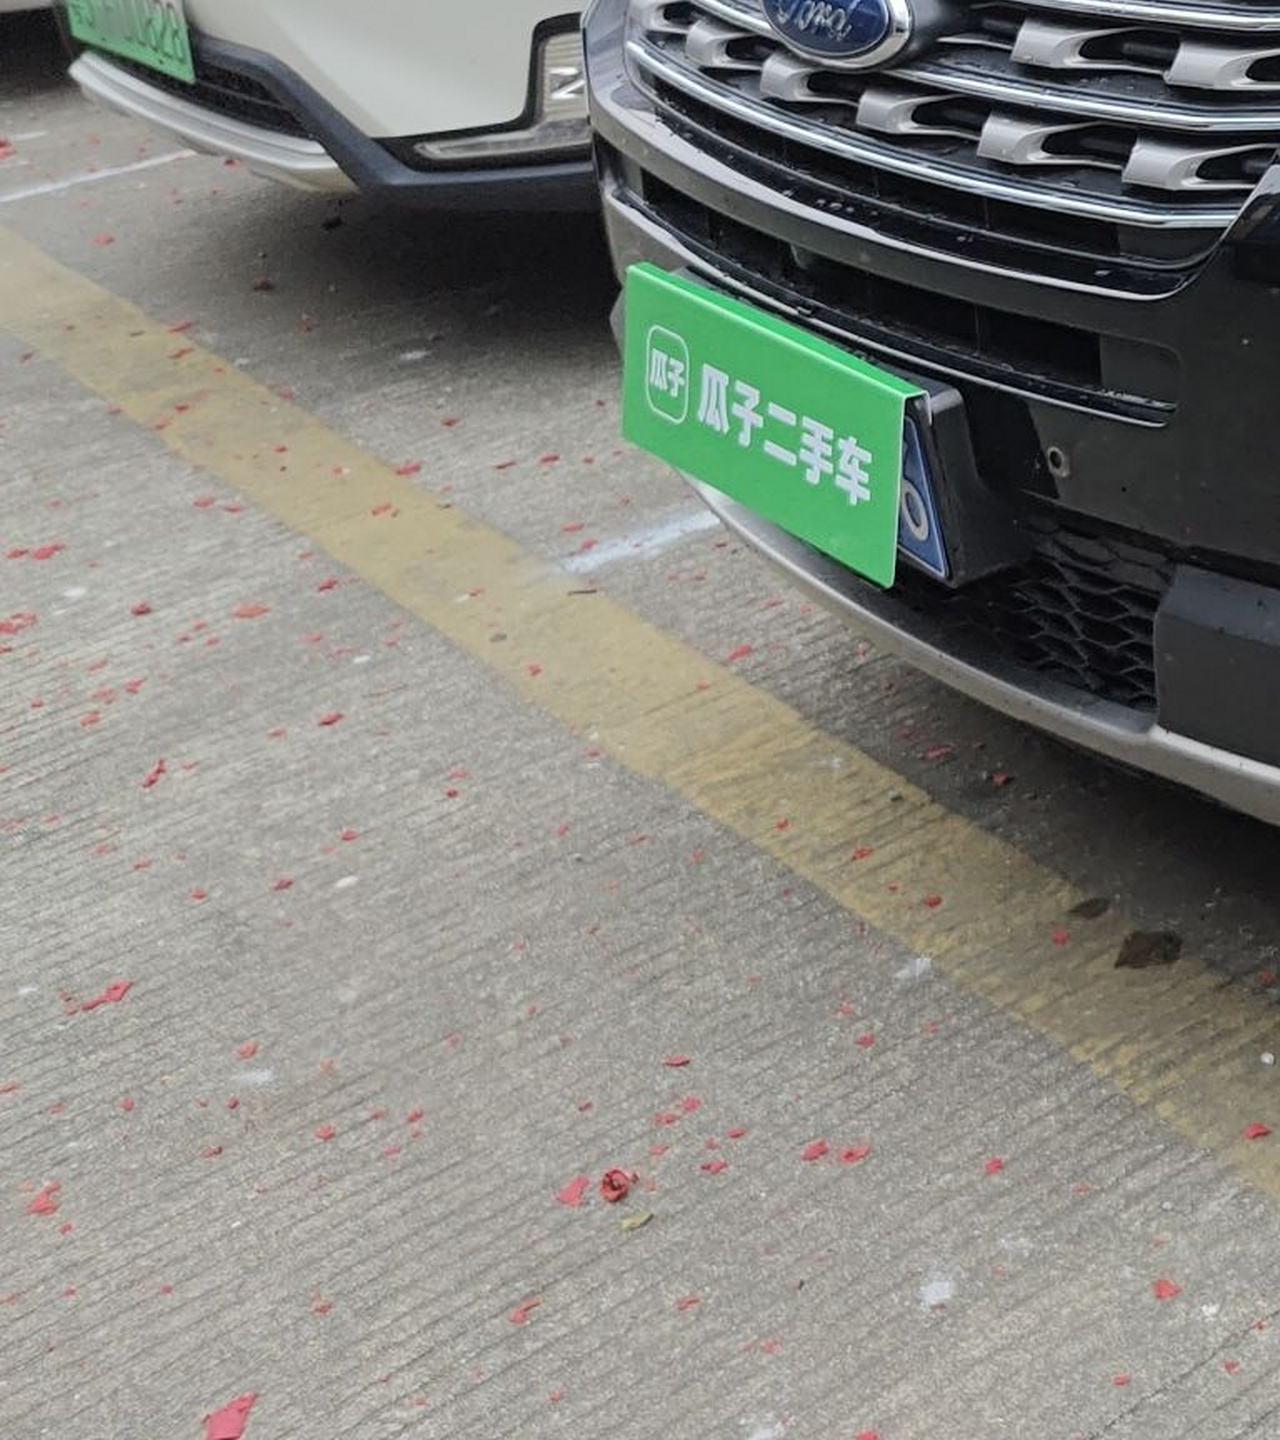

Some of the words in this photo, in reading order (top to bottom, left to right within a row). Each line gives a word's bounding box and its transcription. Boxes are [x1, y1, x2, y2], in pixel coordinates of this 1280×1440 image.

[649, 347, 686, 398] 瓜子
[697, 362, 873, 507] 瓜子二手车
